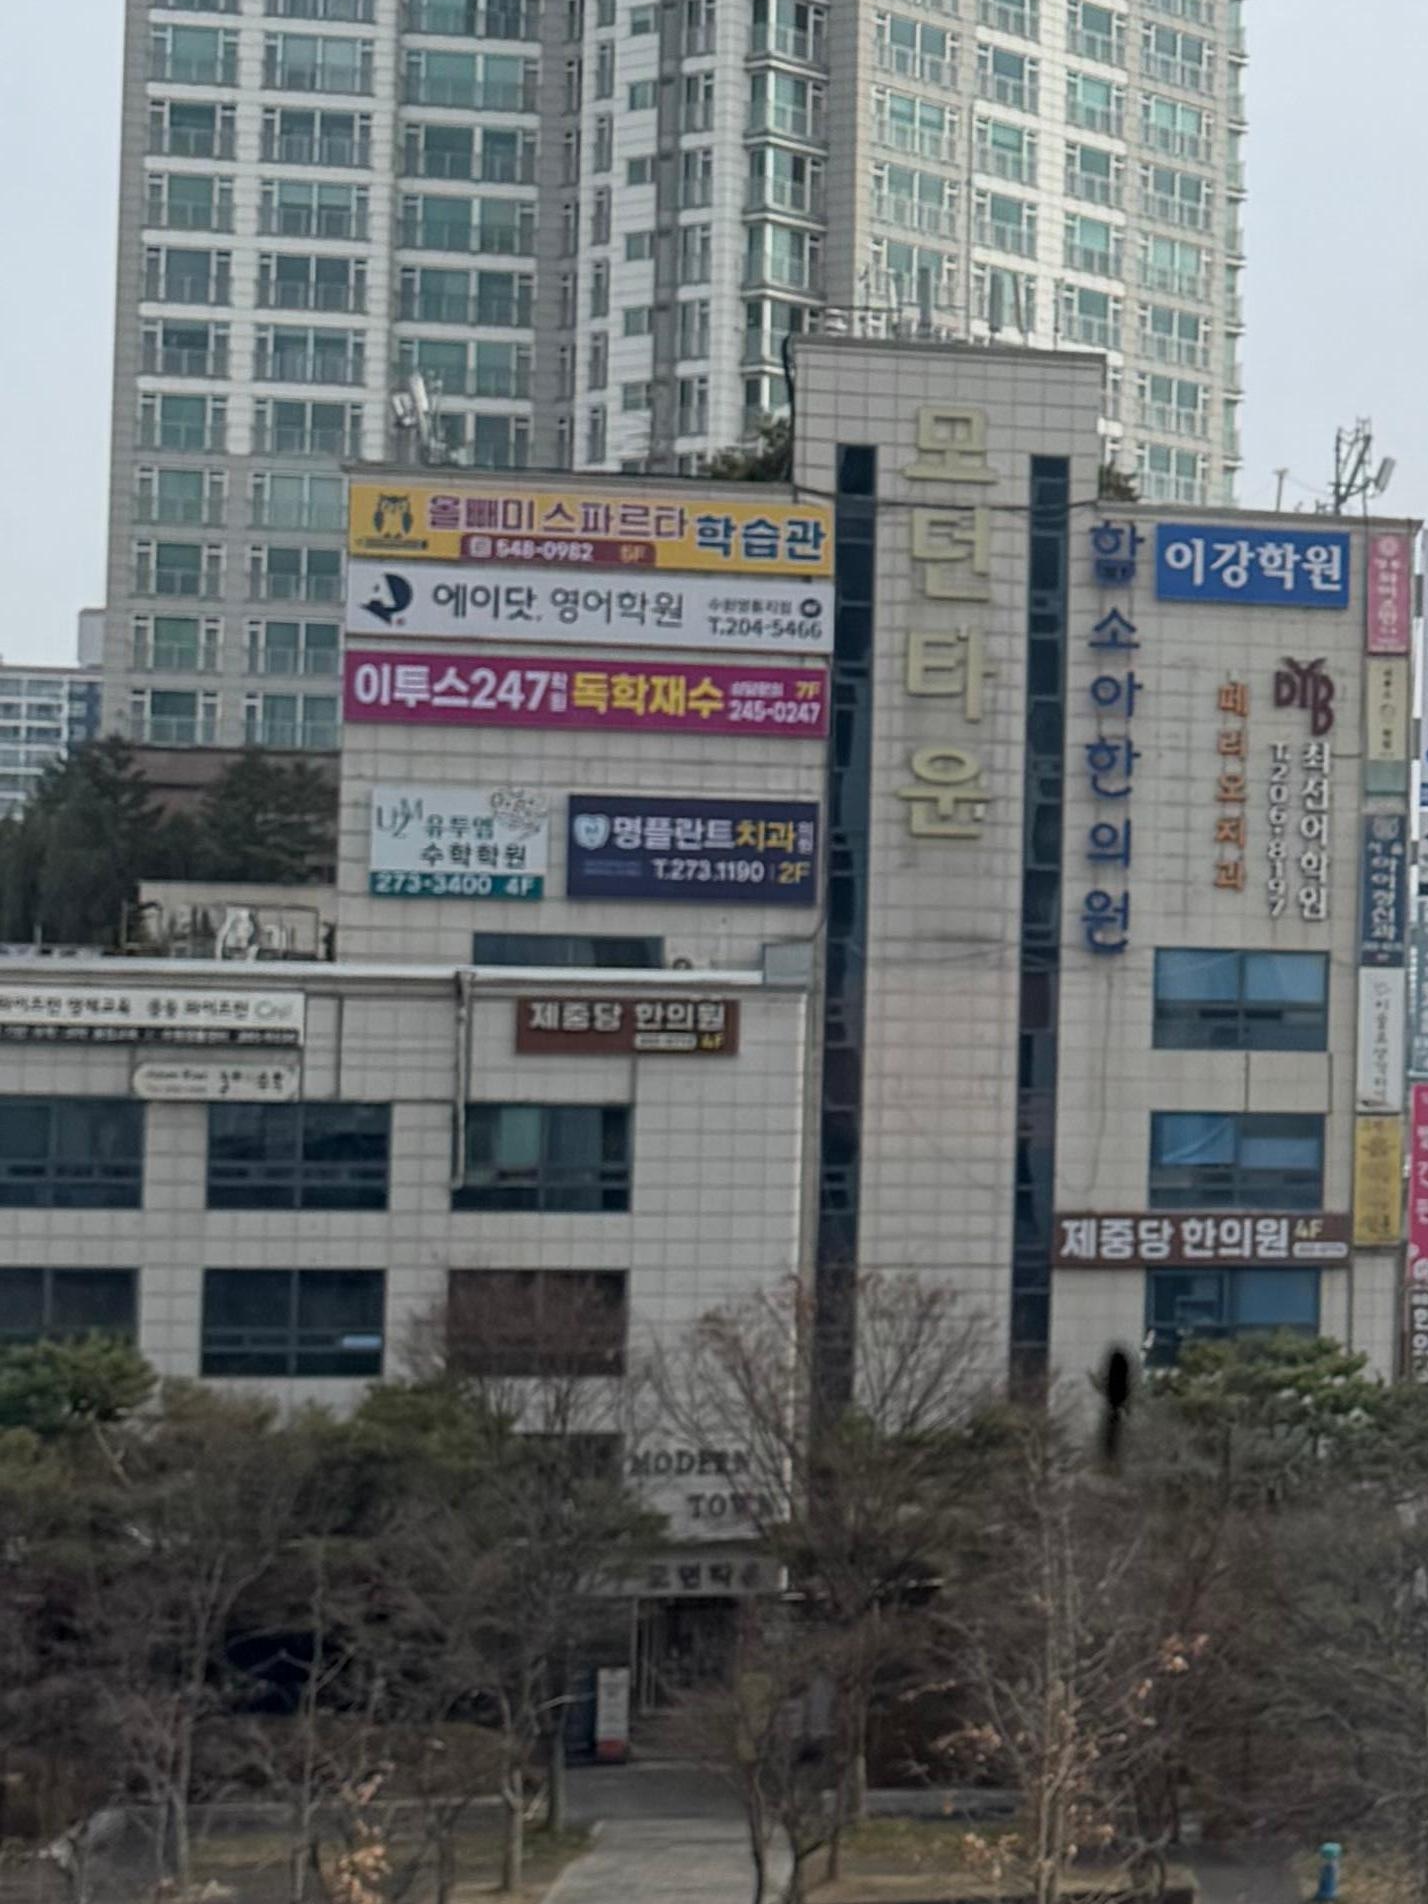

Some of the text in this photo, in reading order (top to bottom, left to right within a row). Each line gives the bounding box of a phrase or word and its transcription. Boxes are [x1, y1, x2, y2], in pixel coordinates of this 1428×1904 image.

[695, 514, 827, 563] 학습관
[1164, 536, 1343, 592] 이강학원
[550, 587, 685, 630] 영어학원
[899, 405, 997, 838] 모던타운
[354, 664, 549, 712] 이투스247
[572, 671, 724, 718] 독학재수
[1274, 656, 1336, 737] DYB
[613, 815, 797, 854] 명플란트치과
[1299, 741, 1332, 921] 최선어학원
[420, 843, 528, 869] 수학학원
[778, 860, 812, 884] 2F
[375, 874, 535, 897] 273-3400 4F
[1060, 1217, 1175, 1259] 제중당
[1181, 1217, 1289, 1259] 한의원
